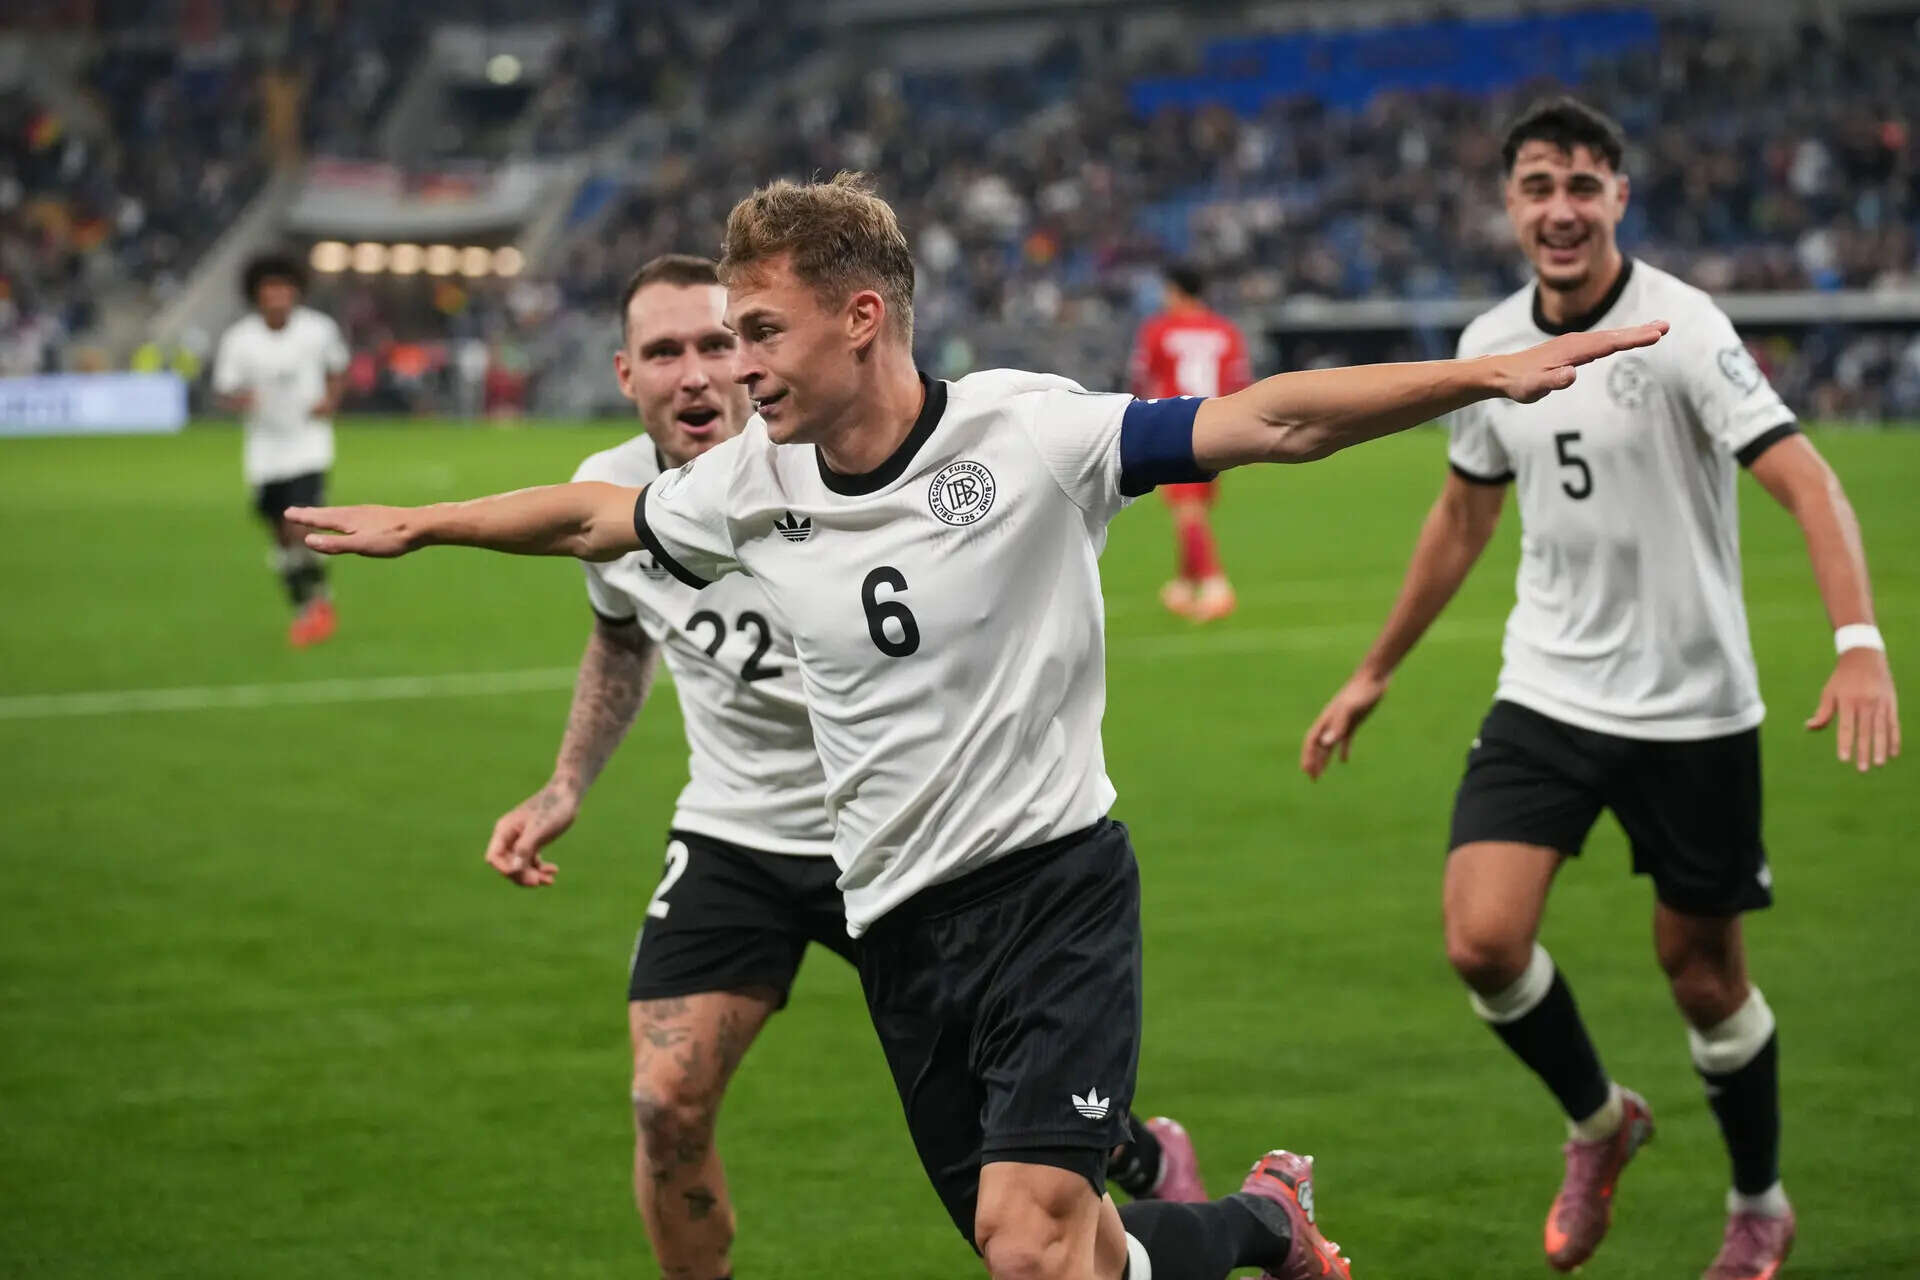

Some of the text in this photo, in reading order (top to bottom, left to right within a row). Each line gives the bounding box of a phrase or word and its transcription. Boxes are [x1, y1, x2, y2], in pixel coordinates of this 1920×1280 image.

[932, 473, 953, 521] DEUTSCHER
[1554, 431, 1593, 501] 5
[960, 513, 975, 522] 125
[685, 611, 784, 682] 22
[861, 566, 920, 657] 6
[646, 839, 690, 919] 2
